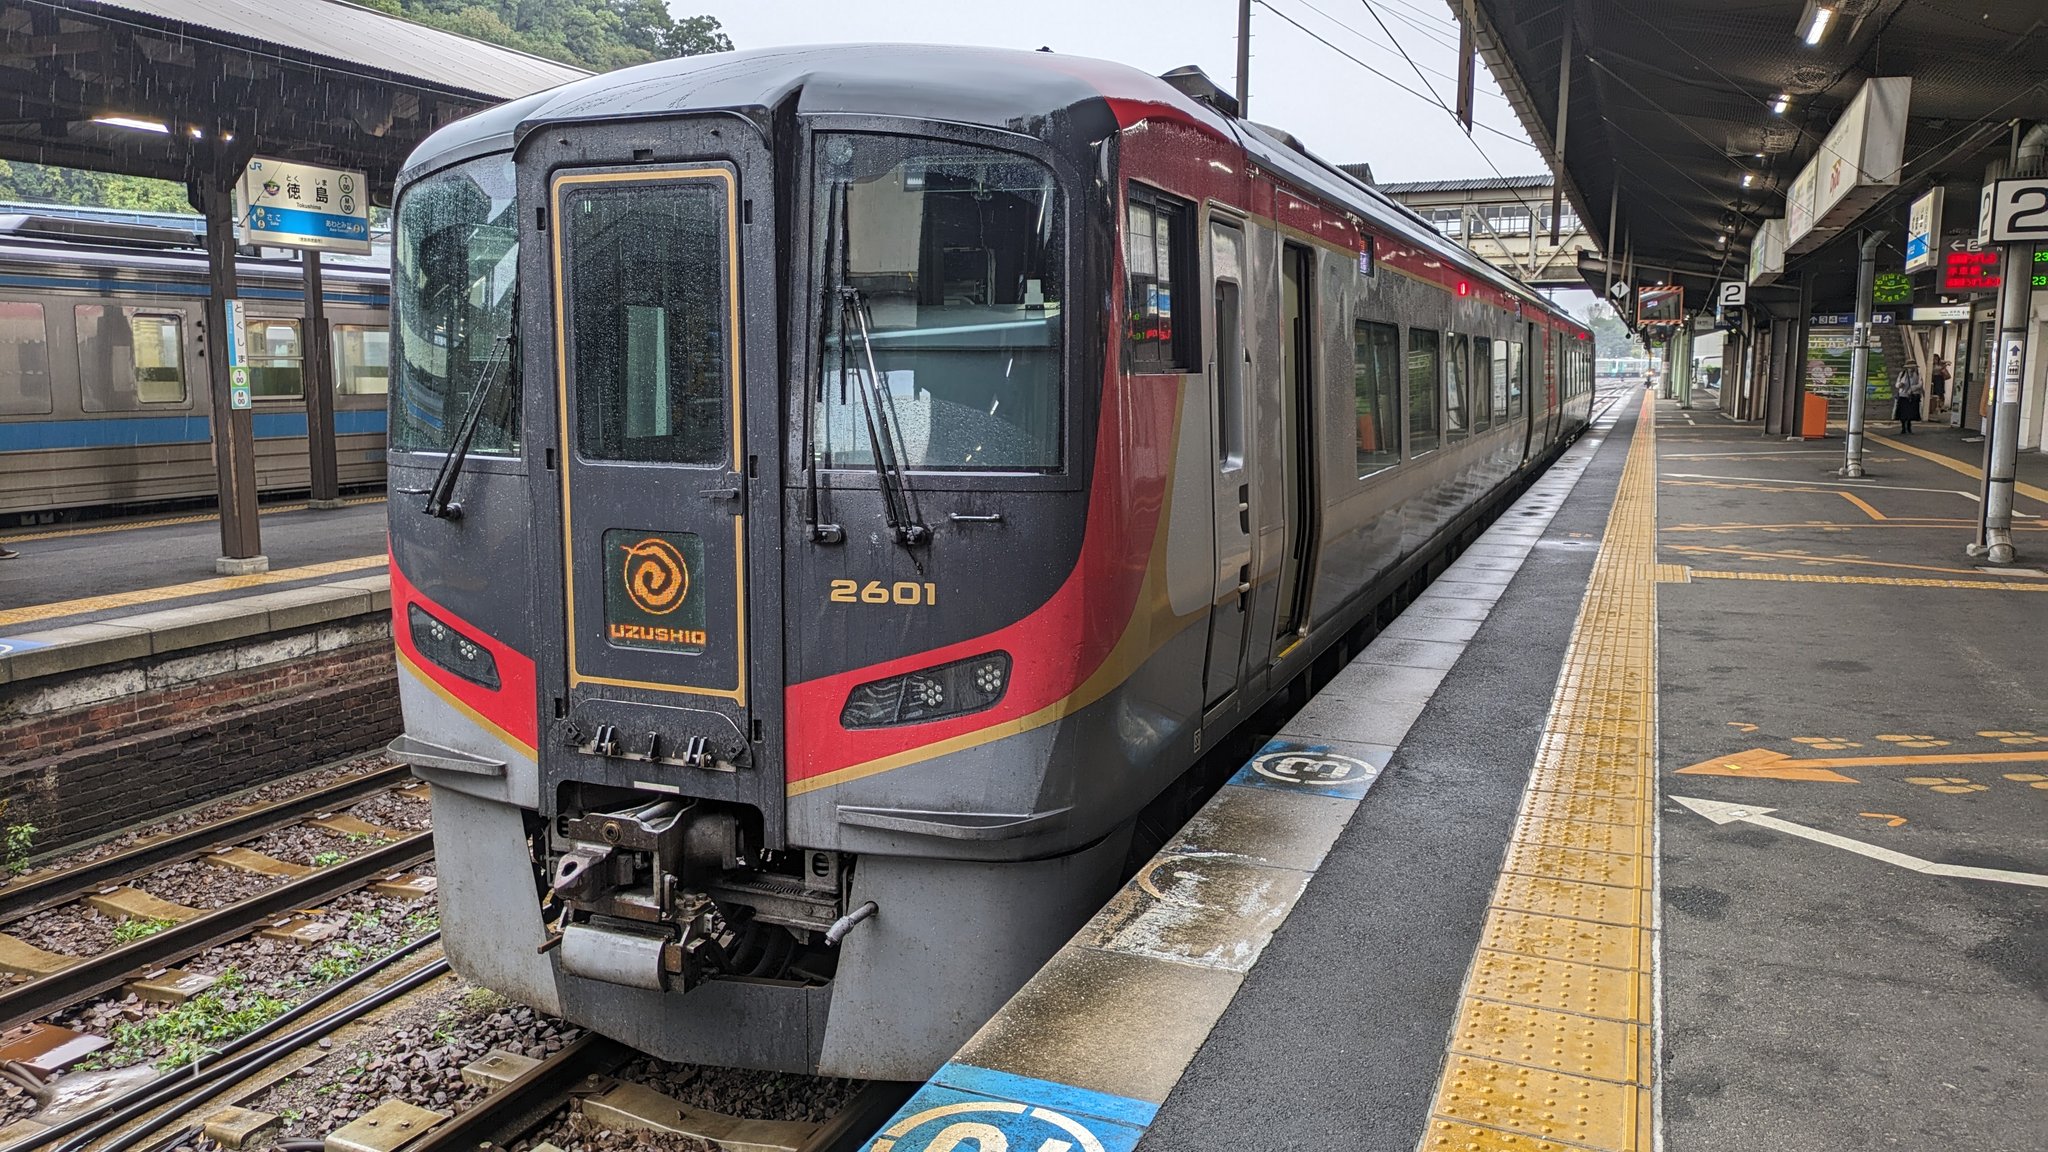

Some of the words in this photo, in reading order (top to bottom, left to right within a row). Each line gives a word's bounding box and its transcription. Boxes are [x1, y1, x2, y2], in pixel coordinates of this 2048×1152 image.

[249, 162, 262, 171] JR
[296, 202, 322, 211] Tokushima
[1980, 192, 1991, 237] 2
[2007, 187, 2048, 233] 2
[1617, 284, 1623, 296] 1
[1724, 285, 1741, 302] 2
[235, 304, 245, 363] とくしま
[830, 579, 936, 606] 2601
[610, 623, 706, 646] UZUSHIO
